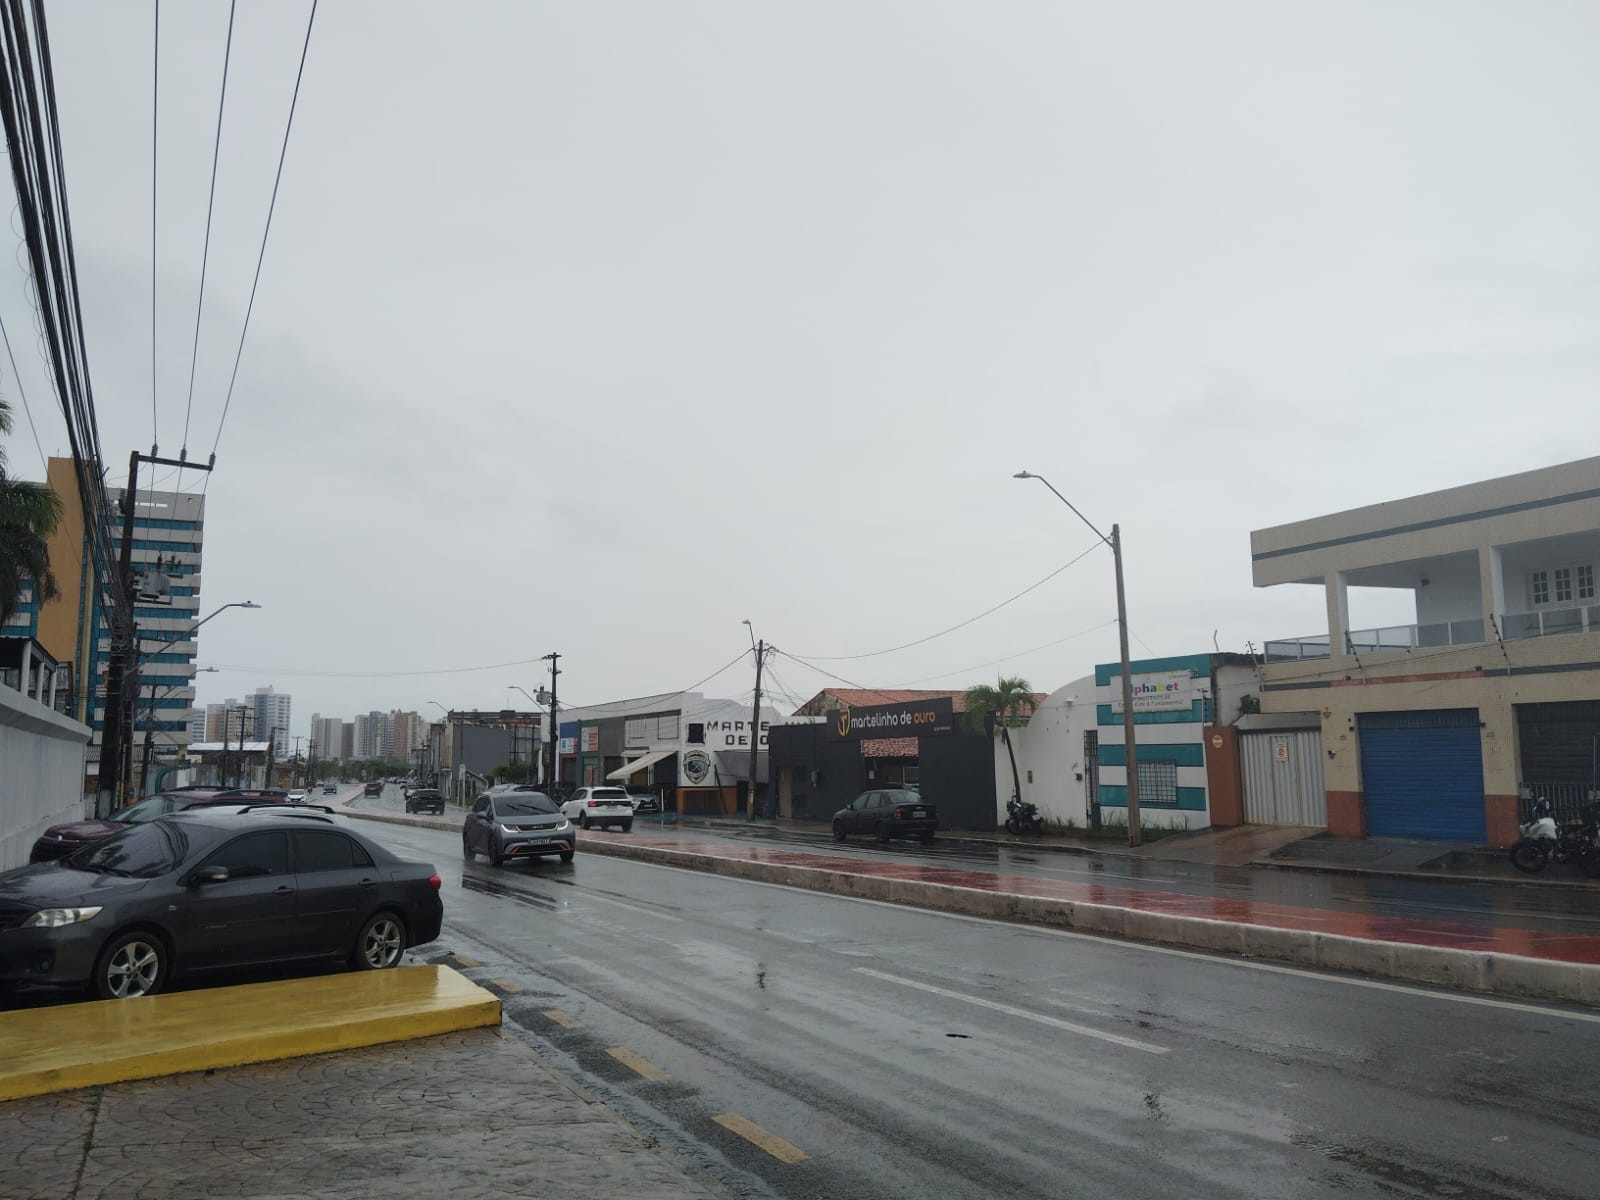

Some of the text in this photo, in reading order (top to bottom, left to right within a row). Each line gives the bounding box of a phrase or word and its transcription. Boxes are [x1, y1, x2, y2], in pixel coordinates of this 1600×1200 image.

[1129, 682, 1179, 696] lphabet
[851, 710, 936, 729] martelinho de ouro
[725, 734, 748, 746] DE
